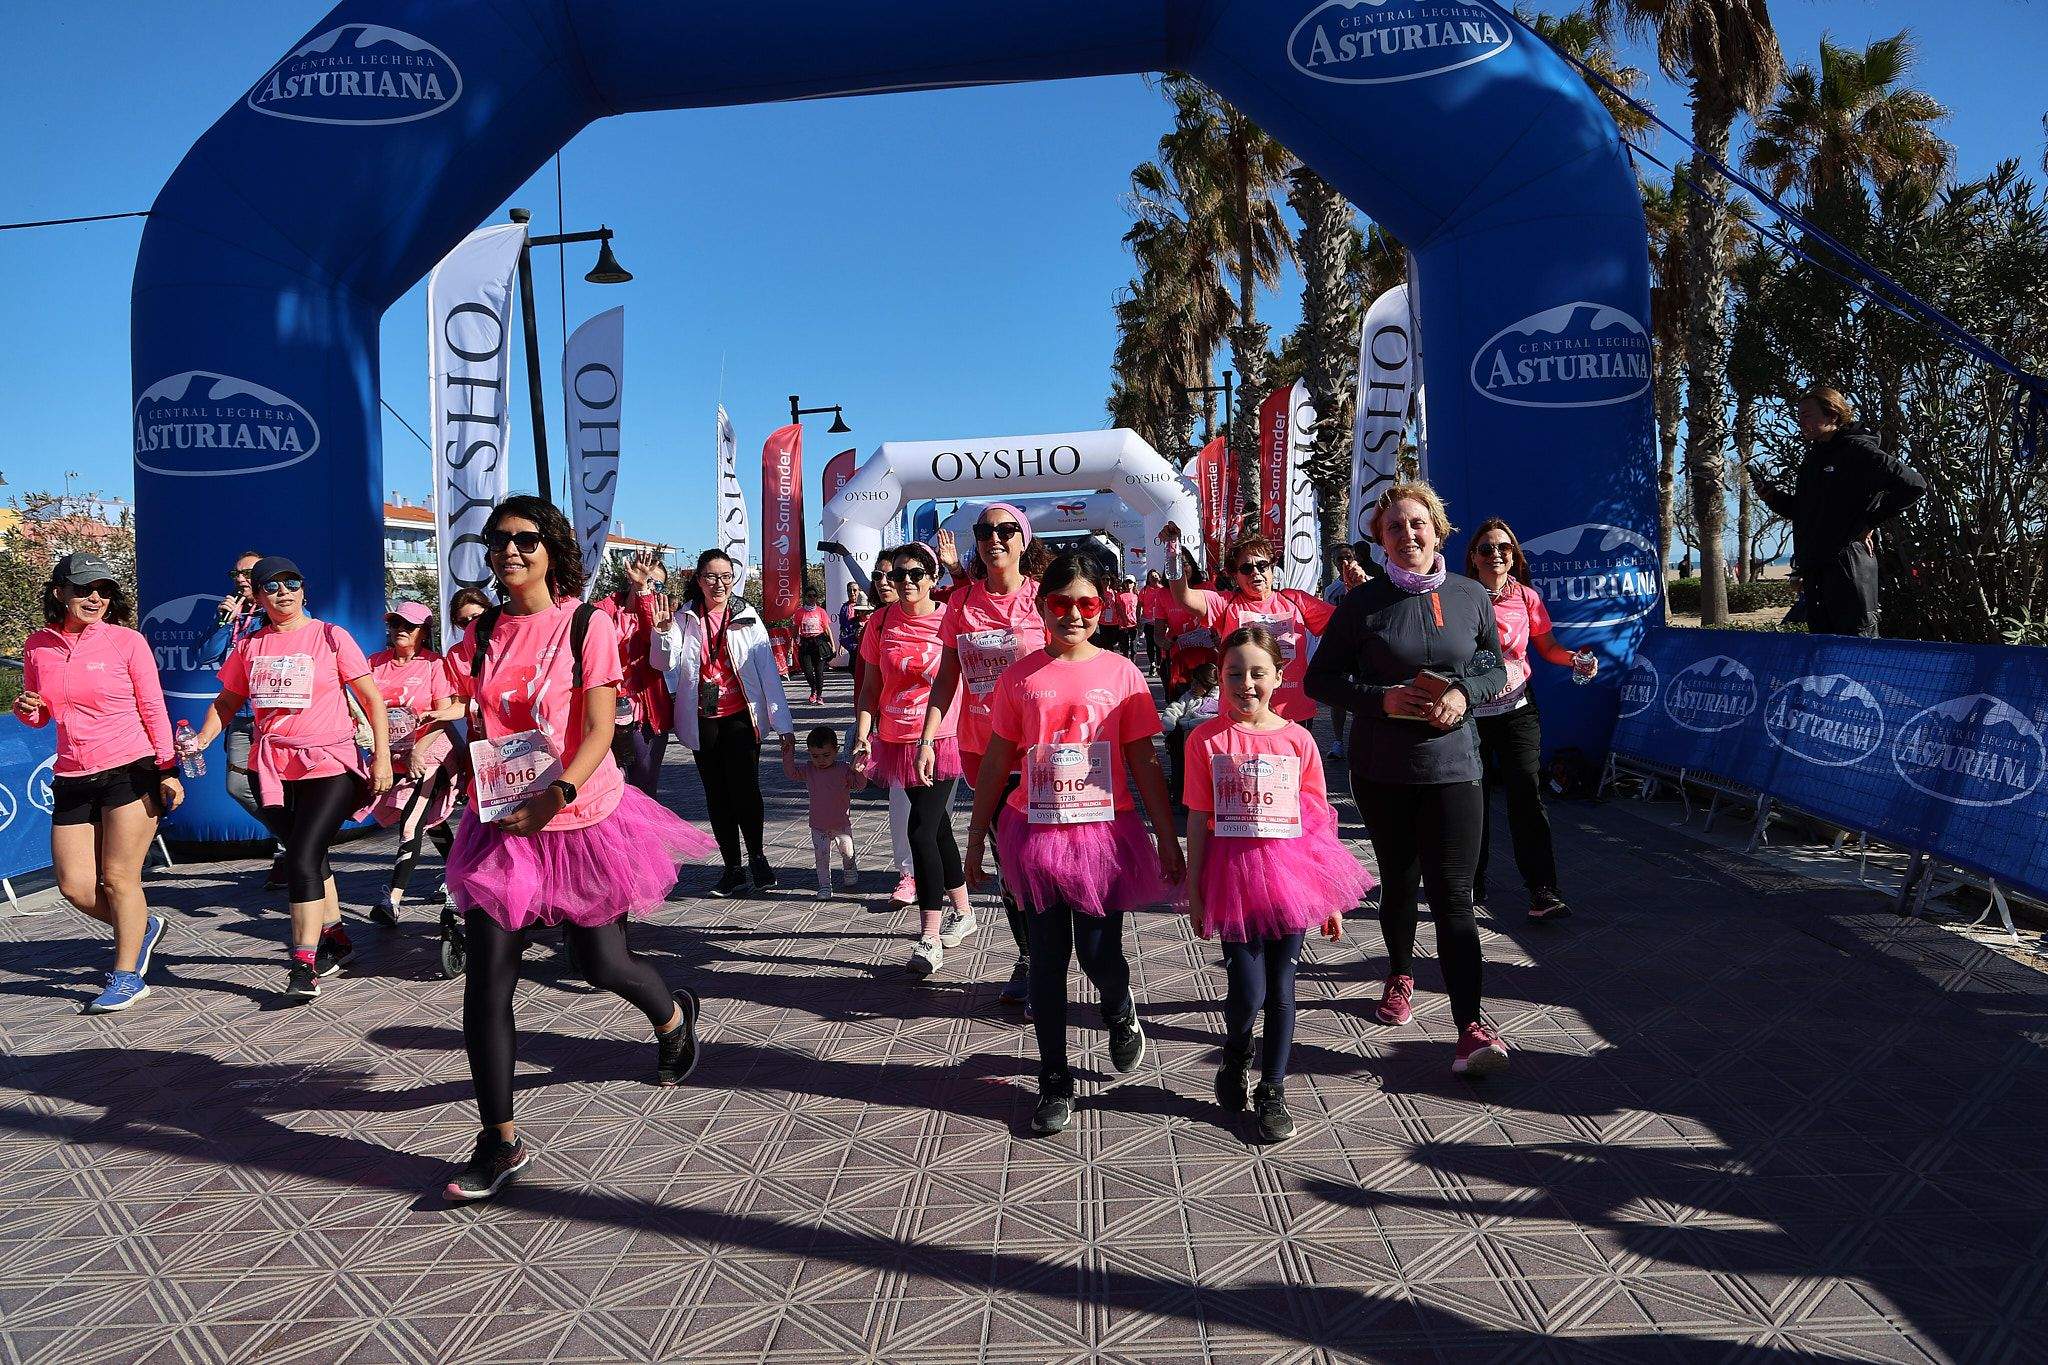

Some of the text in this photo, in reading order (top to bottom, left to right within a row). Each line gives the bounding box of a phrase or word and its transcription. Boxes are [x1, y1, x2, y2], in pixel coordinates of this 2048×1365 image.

[1340, 7, 1487, 29] CENTRAL LECHERA
[1306, 21, 1502, 67] ASTURIANA
[291, 54, 435, 72] CENTRAL LECHERA
[256, 70, 446, 104] ASTURIANA
[1519, 336, 1645, 354] CENTRAL LECHERA
[1485, 349, 1649, 389] ASTURIANA
[149, 407, 295, 421] CENTRAL LECHERA
[135, 415, 304, 453] ASTURIANA
[445, 302, 503, 590] OYSHO
[1269, 411, 1286, 501] Santander
[931, 445, 1081, 482] OYSHO
[1125, 472, 1171, 486] OYSHO
[844, 490, 889, 502] OYSHO
[1207, 460, 1218, 527] Santander
[775, 448, 791, 607] Sports Santander
[1153, 534, 1195, 547] OHO
[828, 551, 869, 563] OYHO
[1530, 559, 1600, 573] CENTRAL
[1533, 570, 1658, 602] STURIANA
[154, 630, 204, 641] CENTR
[269, 678, 292, 687] 016
[1668, 680, 1748, 716] ASTURIANA
[1767, 694, 1871, 751] ASTURIANA
[1898, 725, 2027, 790] ASTURIANA
[505, 768, 536, 785] 016
[1053, 778, 1085, 793] 016
[1241, 790, 1274, 805] 016
